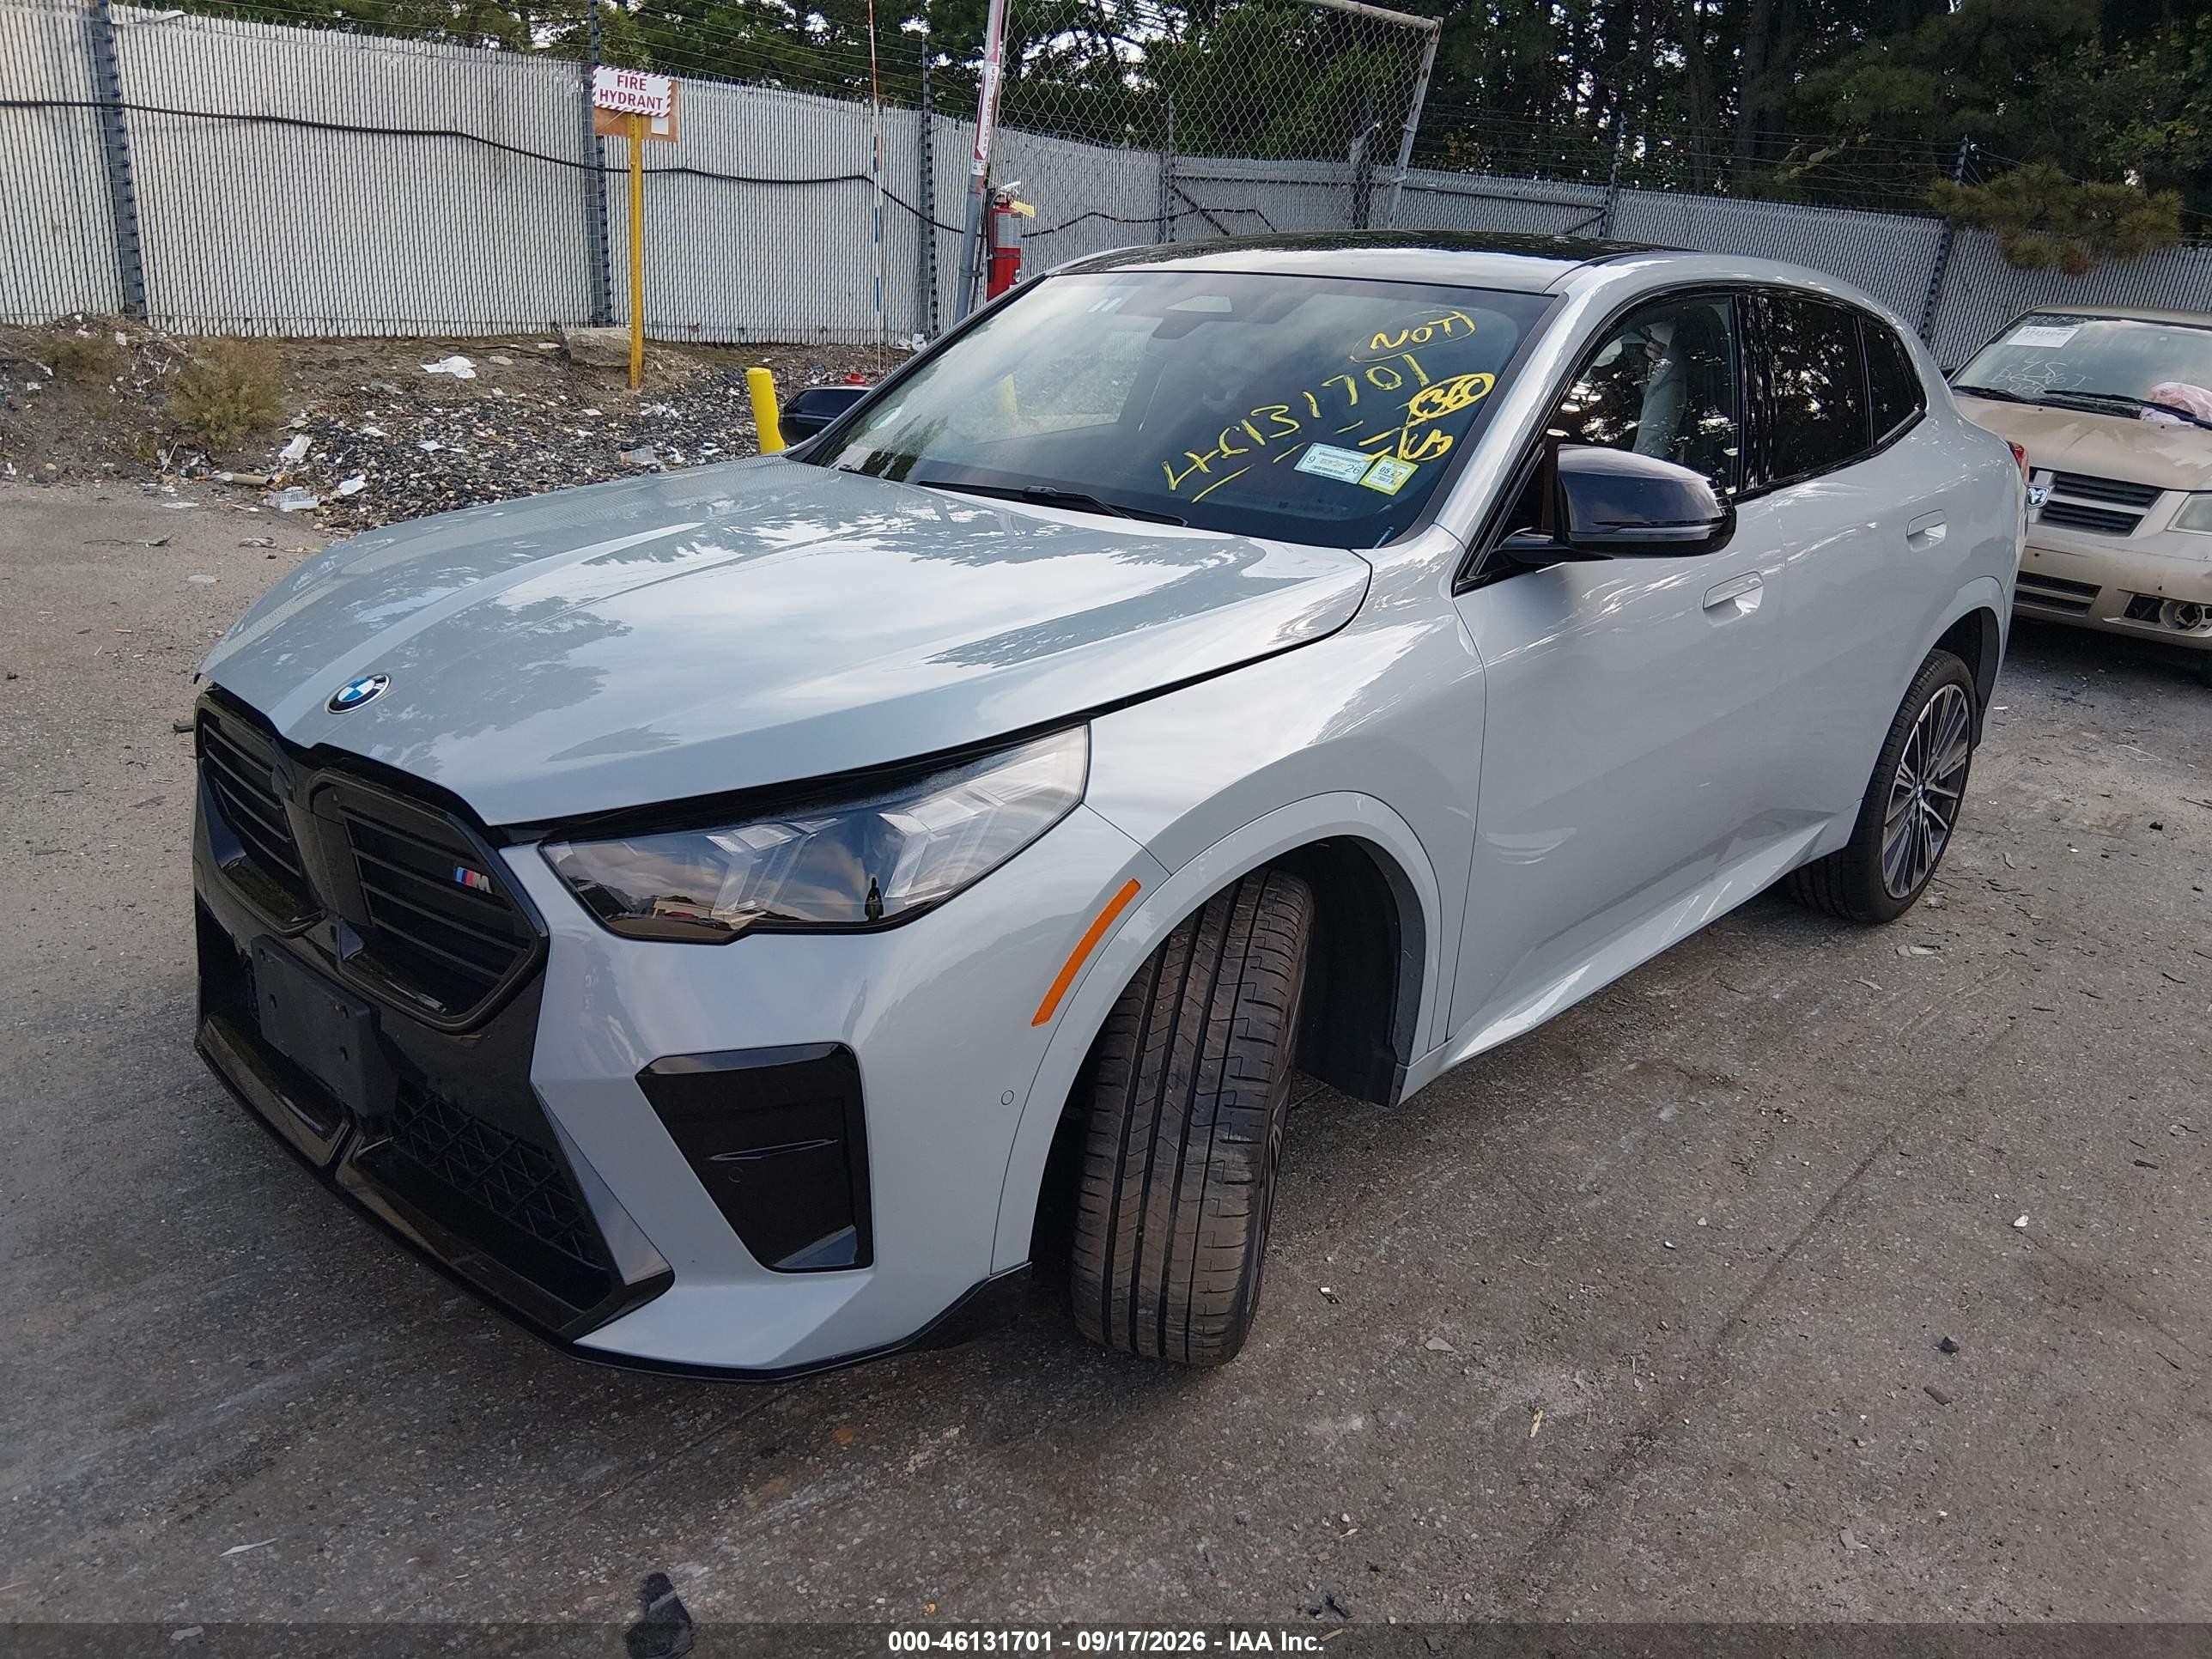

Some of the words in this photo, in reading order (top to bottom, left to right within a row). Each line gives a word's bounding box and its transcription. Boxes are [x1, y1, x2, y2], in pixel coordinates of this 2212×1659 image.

[617, 74, 647, 91] FIRE
[599, 88, 663, 110] HYDRANT
[1306, 455, 1316, 465] 9
[1344, 464, 1362, 475] 26
